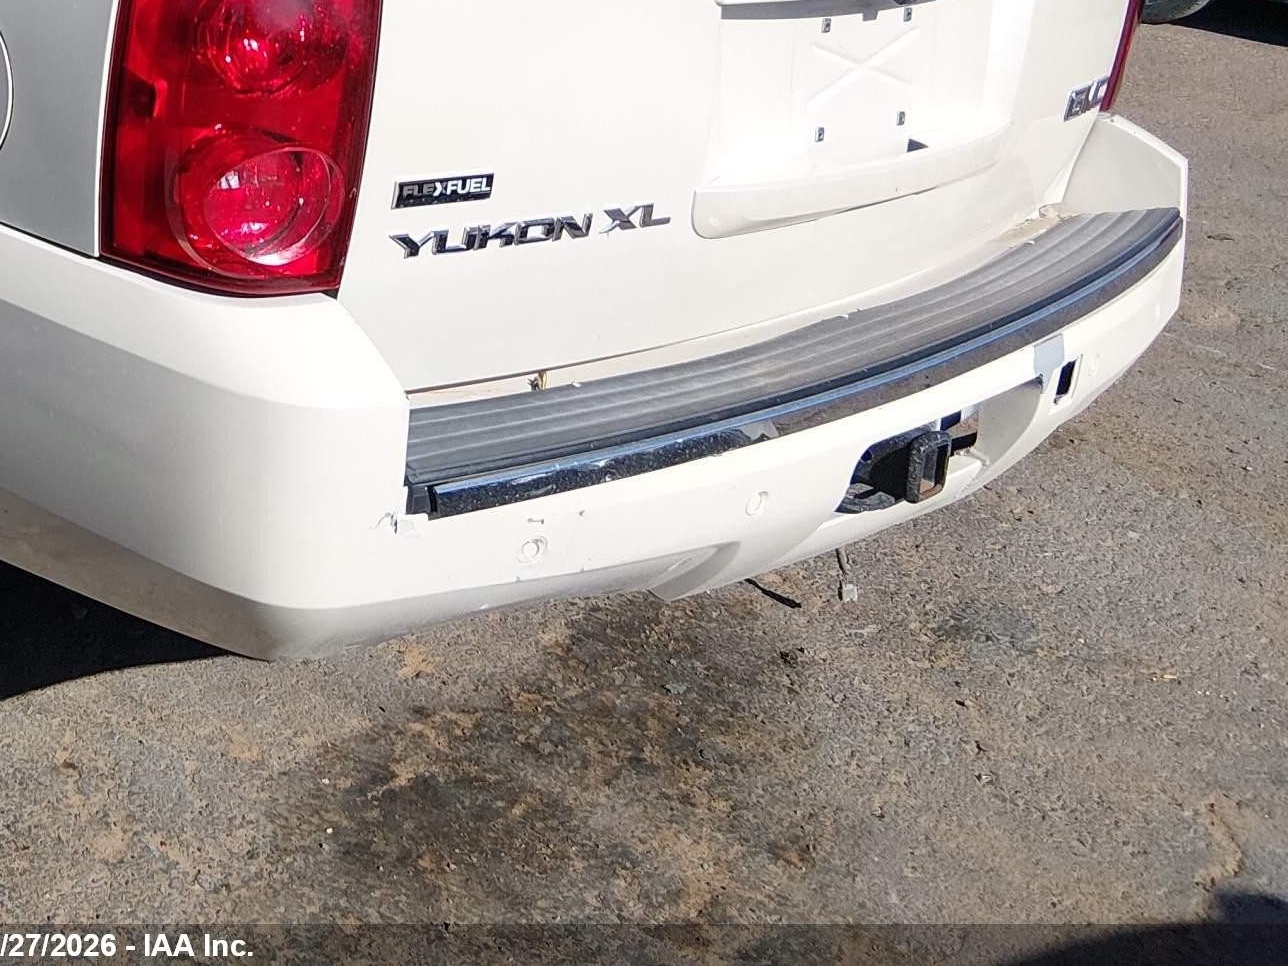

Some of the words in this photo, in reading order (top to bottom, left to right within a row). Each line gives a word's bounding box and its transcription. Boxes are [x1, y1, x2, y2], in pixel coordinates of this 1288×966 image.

[402, 177, 492, 200] FLEXFUEL
[388, 212, 594, 260] YUKON
[599, 202, 672, 234] XL
